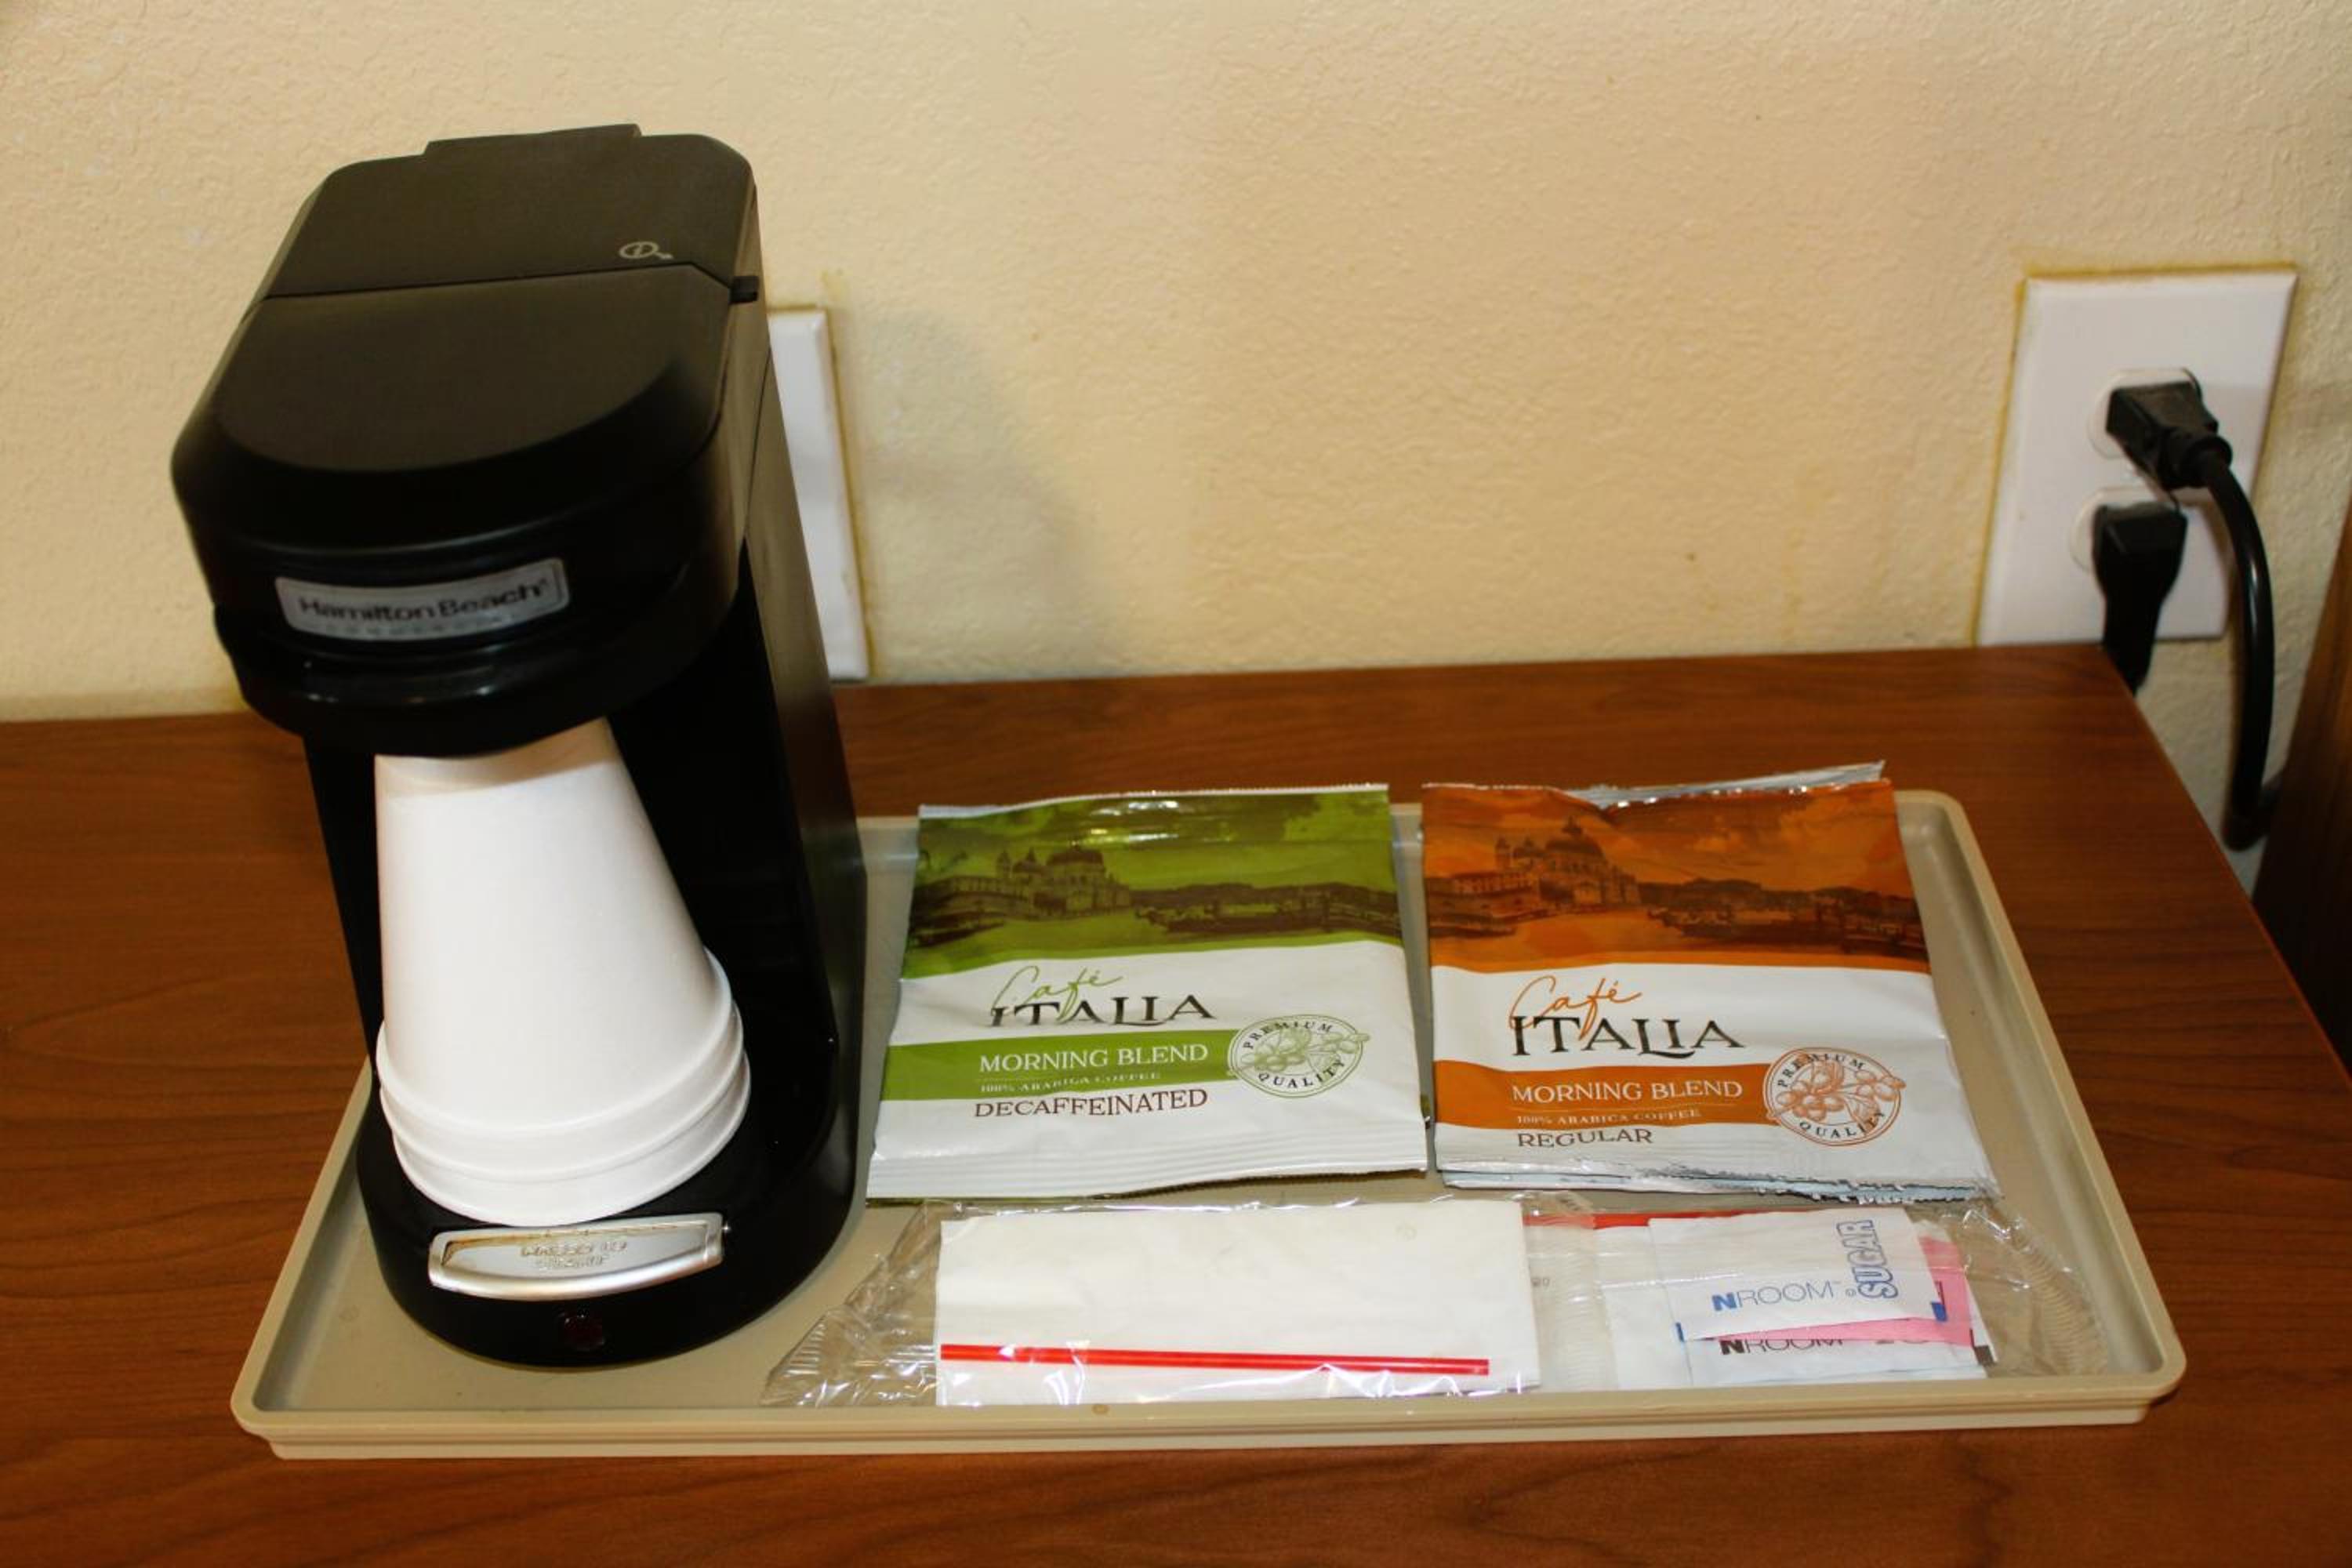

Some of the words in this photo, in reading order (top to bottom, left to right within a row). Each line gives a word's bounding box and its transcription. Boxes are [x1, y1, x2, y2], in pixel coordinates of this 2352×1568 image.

[299, 597, 433, 622] Hamilton
[437, 582, 543, 618] Beach
[990, 965, 1123, 1023] Café
[1508, 975, 1642, 1040] Café
[989, 994, 1217, 1028] ITALIA
[1243, 1021, 1333, 1050] PREMIUM
[1512, 1014, 1745, 1058] ITALIA
[979, 1047, 1109, 1073] MORNING
[1118, 1044, 1209, 1065] BLEND
[1258, 1058, 1345, 1089] QUALITY
[975, 1088, 1208, 1118] DECAFFEINATED
[1512, 1080, 1643, 1104] MORNING
[1651, 1080, 1743, 1099] BLEND
[1558, 1113, 1629, 1125] ARABICA
[1634, 1109, 1702, 1121] COFFEE
[1799, 1111, 1885, 1138] QUALITY
[1517, 1128, 1653, 1148] REGULAR
[1836, 1219, 1899, 1298] SUGAR
